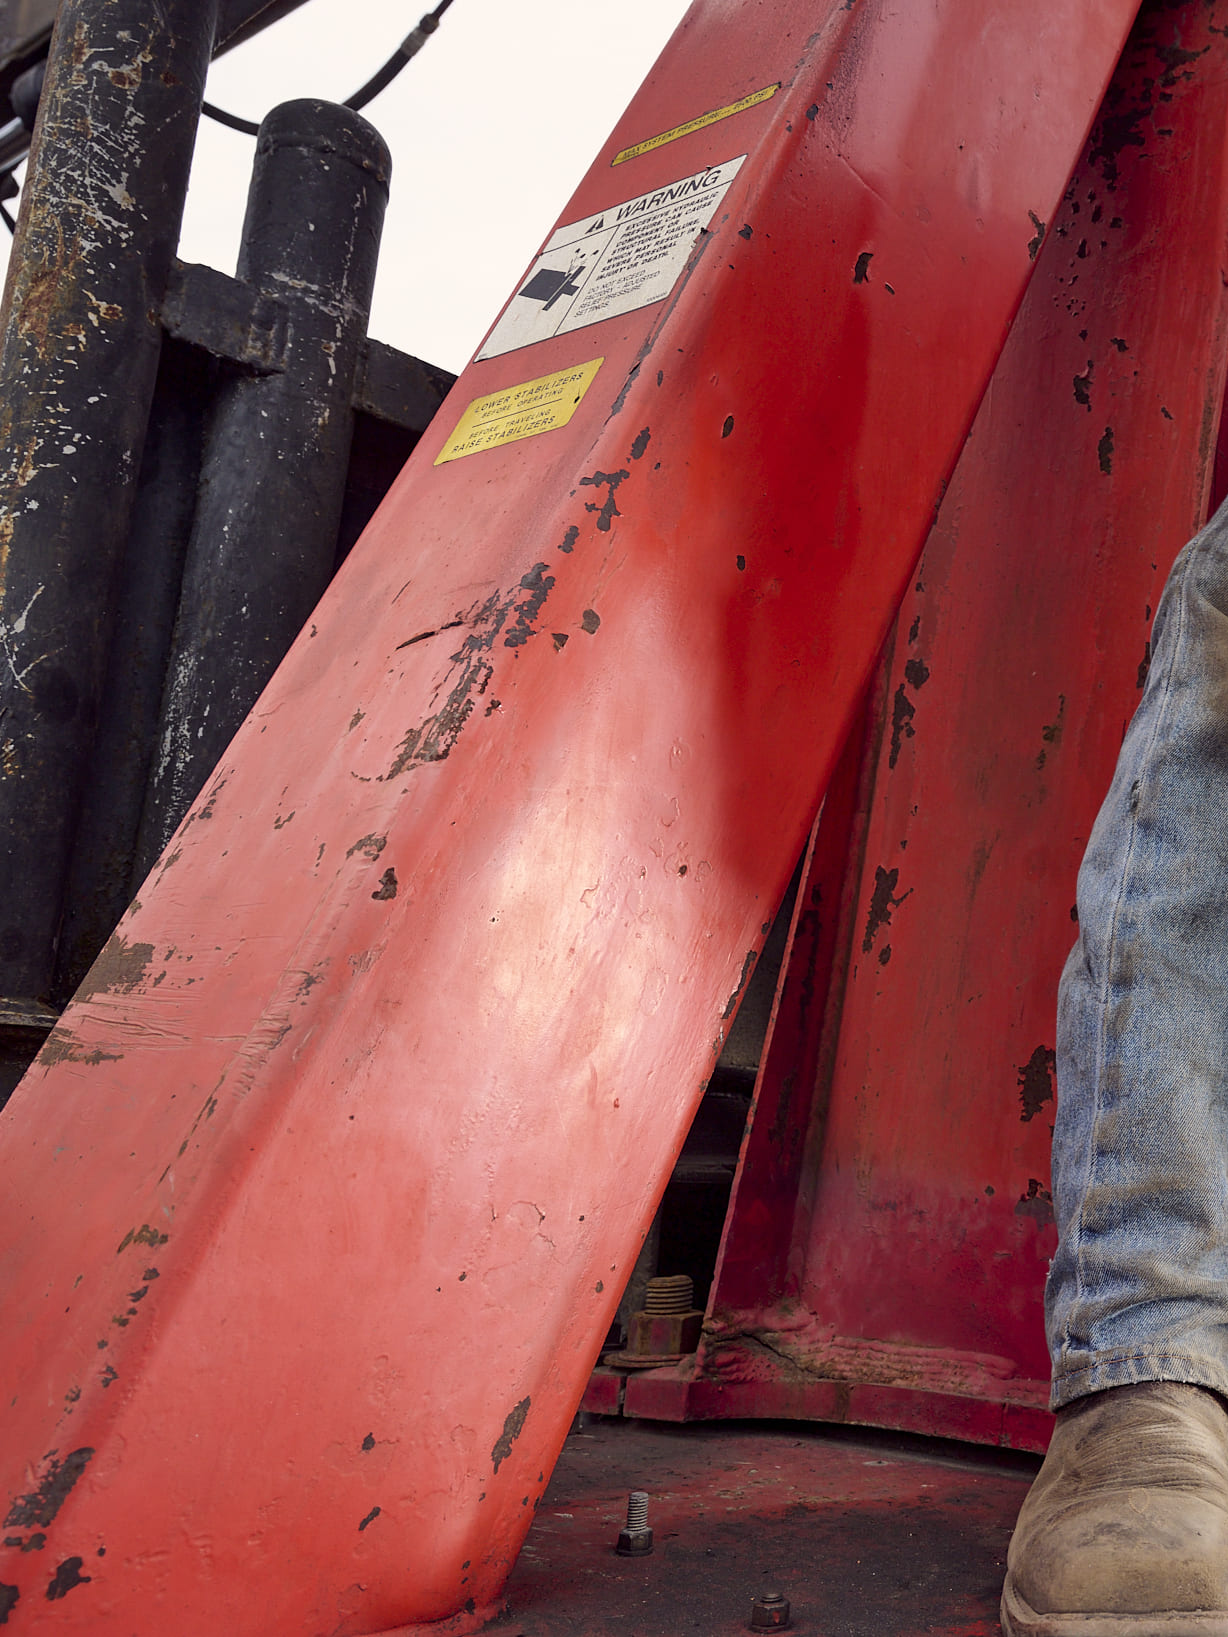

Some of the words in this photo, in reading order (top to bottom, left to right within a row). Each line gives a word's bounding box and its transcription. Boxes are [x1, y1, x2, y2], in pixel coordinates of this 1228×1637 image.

[616, 170, 721, 221] WARNING
[625, 210, 670, 231] EXCESSIVE
[672, 191, 719, 213] HYDRAULIC
[616, 225, 665, 247] COMPONENT
[667, 220, 680, 228] OR
[620, 219, 663, 239] PRESSURE
[665, 212, 682, 222] CAN
[685, 200, 713, 215] CAUSE
[601, 257, 632, 273] SEVERE
[634, 241, 676, 261] PERSONAL
[607, 250, 632, 264] WHICH
[634, 244, 651, 253] MAY
[654, 231, 686, 247] RESULT
[611, 233, 661, 256] STRUCTURAL
[583, 287, 613, 302] FACTORY
[623, 270, 660, 288] ADJUSTED
[587, 286, 599, 294] DO
[600, 280, 617, 290] NOT
[617, 269, 646, 284] EXCEED
[596, 266, 626, 281] INJURY
[627, 262, 639, 270] OR
[578, 297, 602, 310] RELIEF
[603, 283, 642, 301] PRESSURE
[474, 396, 511, 413] LOWER
[514, 372, 584, 400] STABILIZERS
[481, 403, 512, 418] BEFORE
[517, 387, 564, 407] OPERATING
[451, 438, 483, 453] RAISE
[486, 415, 556, 443] STABILIZERS
[468, 425, 499, 439] BEFORE
[505, 409, 551, 427] TRAVELING
